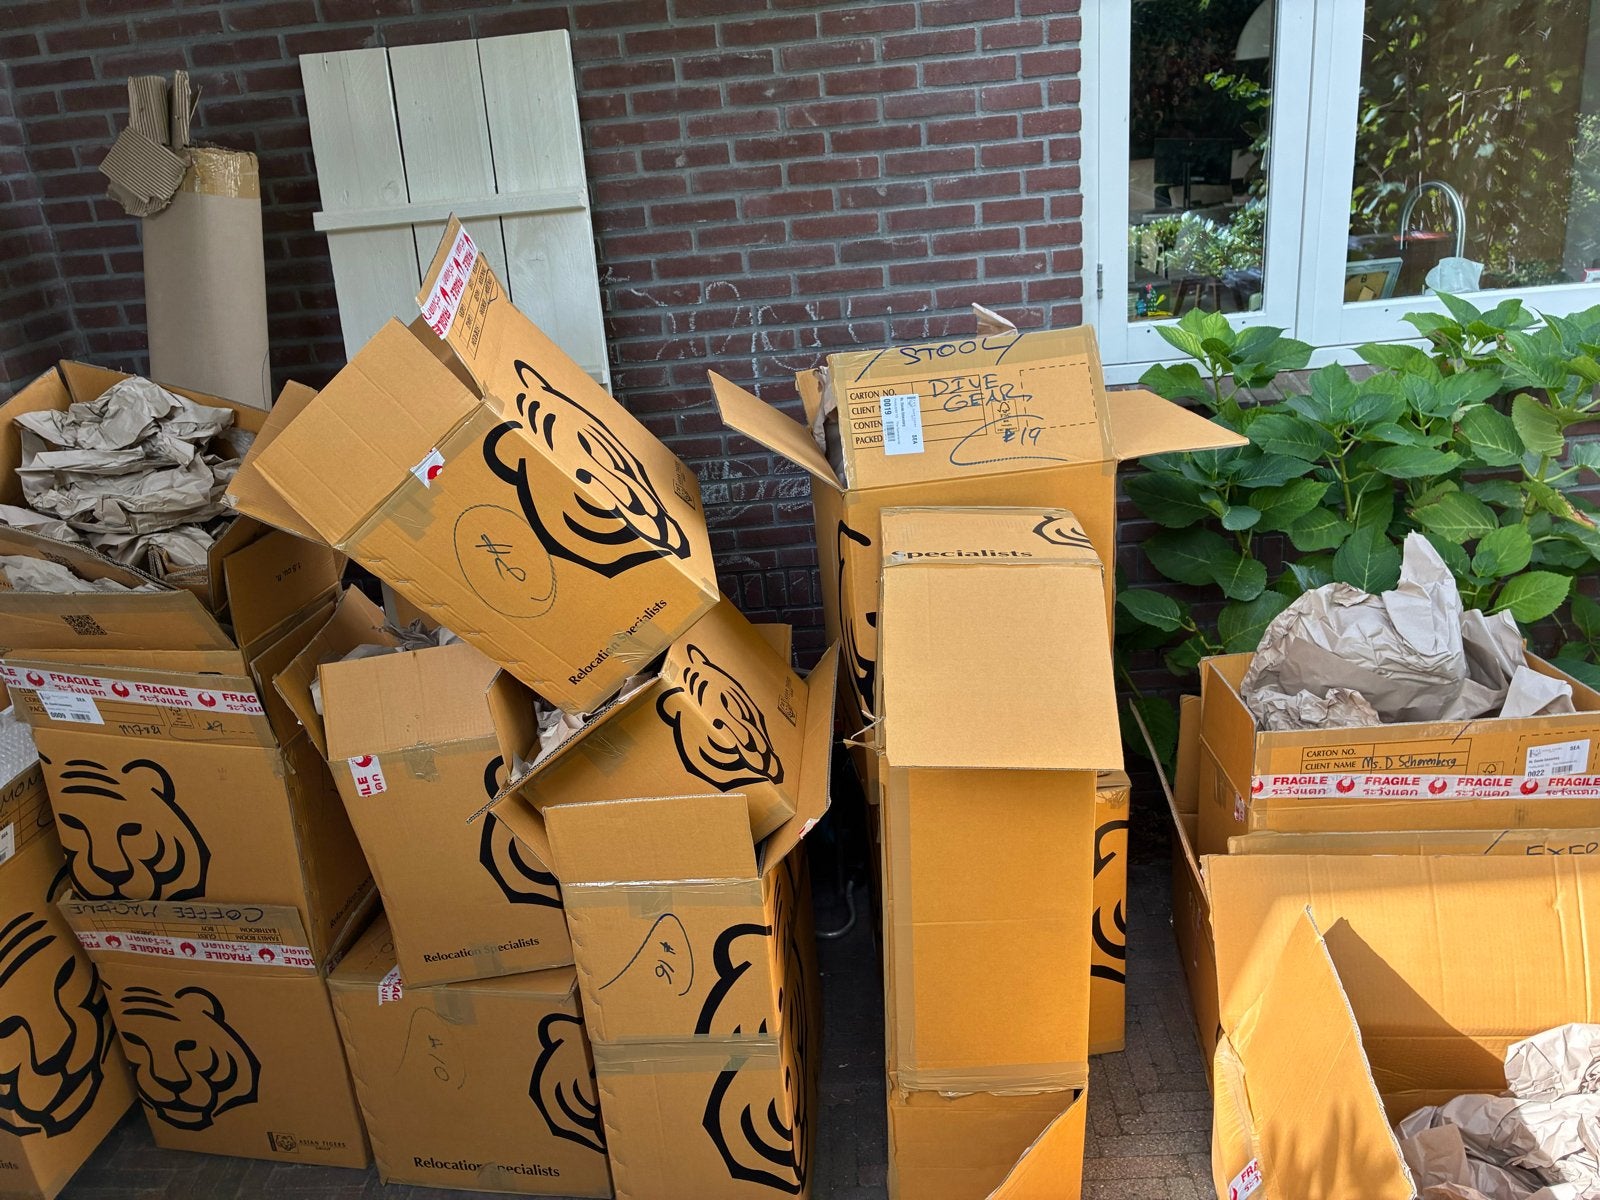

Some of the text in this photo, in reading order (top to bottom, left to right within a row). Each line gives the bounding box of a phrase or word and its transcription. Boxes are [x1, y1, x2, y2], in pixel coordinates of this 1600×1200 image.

[928, 373, 999, 398] DIVE
[849, 388, 897, 401] CARTON NO.
[943, 383, 1033, 413] GEAR
[851, 405, 876, 415] CLIENT
[883, 398, 892, 415] 0019
[855, 434, 883, 445] PACKED
[568, 600, 668, 685] Relocation Specialists
[49, 673, 102, 687] FRAGILE
[134, 684, 188, 698] FRAGILE
[1306, 748, 1357, 758] CARTON NO.
[1305, 760, 1357, 770] CLIENT NAME
[1361, 756, 1382, 769] Ms.
[1385, 756, 1393, 770] D
[1527, 769, 1545, 777] 0022
[1272, 776, 1600, 787] FRAGILE FRAGILE FRAGILE FRAGILE
[1271, 786, 1327, 796] ระวังแตก
[1362, 786, 1419, 797] ระวังแตก
[1455, 787, 1510, 798] ระวังแตก
[71, 902, 264, 923] COFFEE MACHINE
[235, 934, 256, 942] ROOM
[258, 934, 281, 942] FAMILY
[130, 943, 176, 956] FRAGILE
[423, 938, 540, 963] Relocation Specialists
[204, 950, 253, 962] FRAGILE
